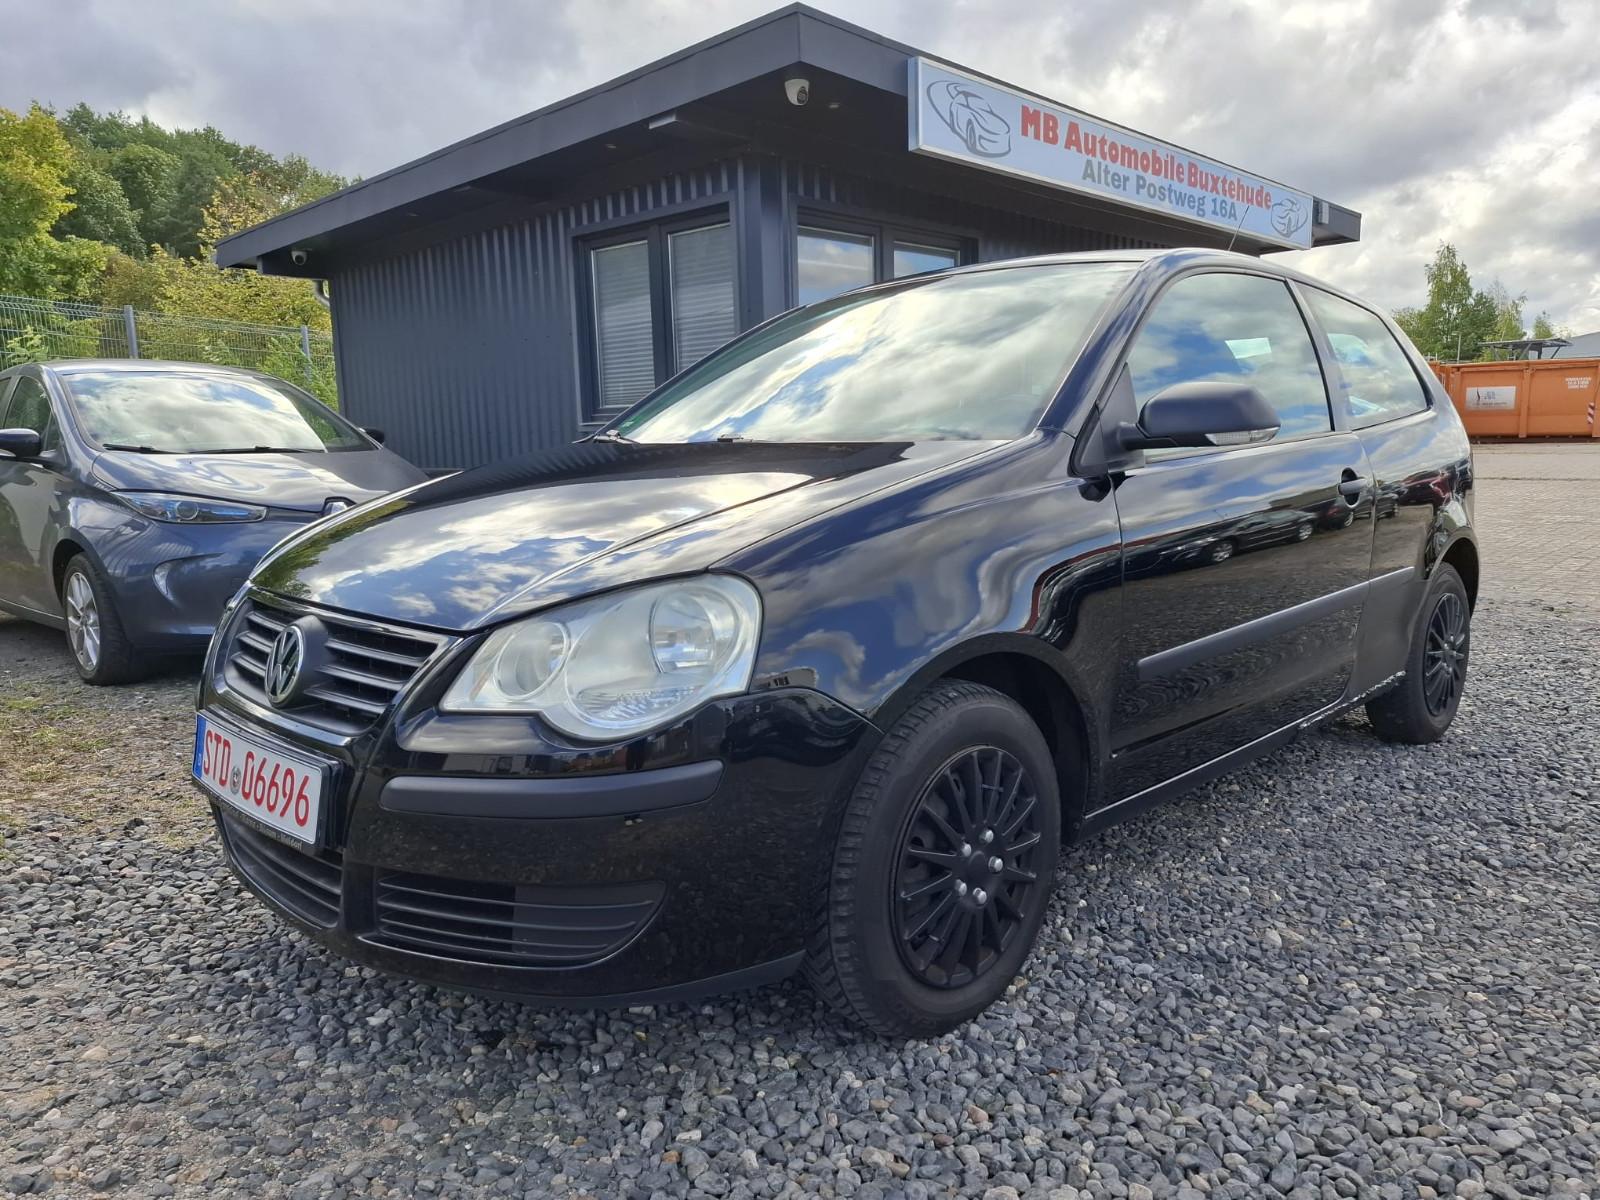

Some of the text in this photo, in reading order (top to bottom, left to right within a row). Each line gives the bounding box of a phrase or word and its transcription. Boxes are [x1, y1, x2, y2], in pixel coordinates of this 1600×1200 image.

[1021, 105, 1272, 209] MB Automobile Buxtehude
[1082, 159, 1238, 221] Alter Postweg 16A
[203, 730, 231, 787] STD
[241, 751, 310, 827] 06696
